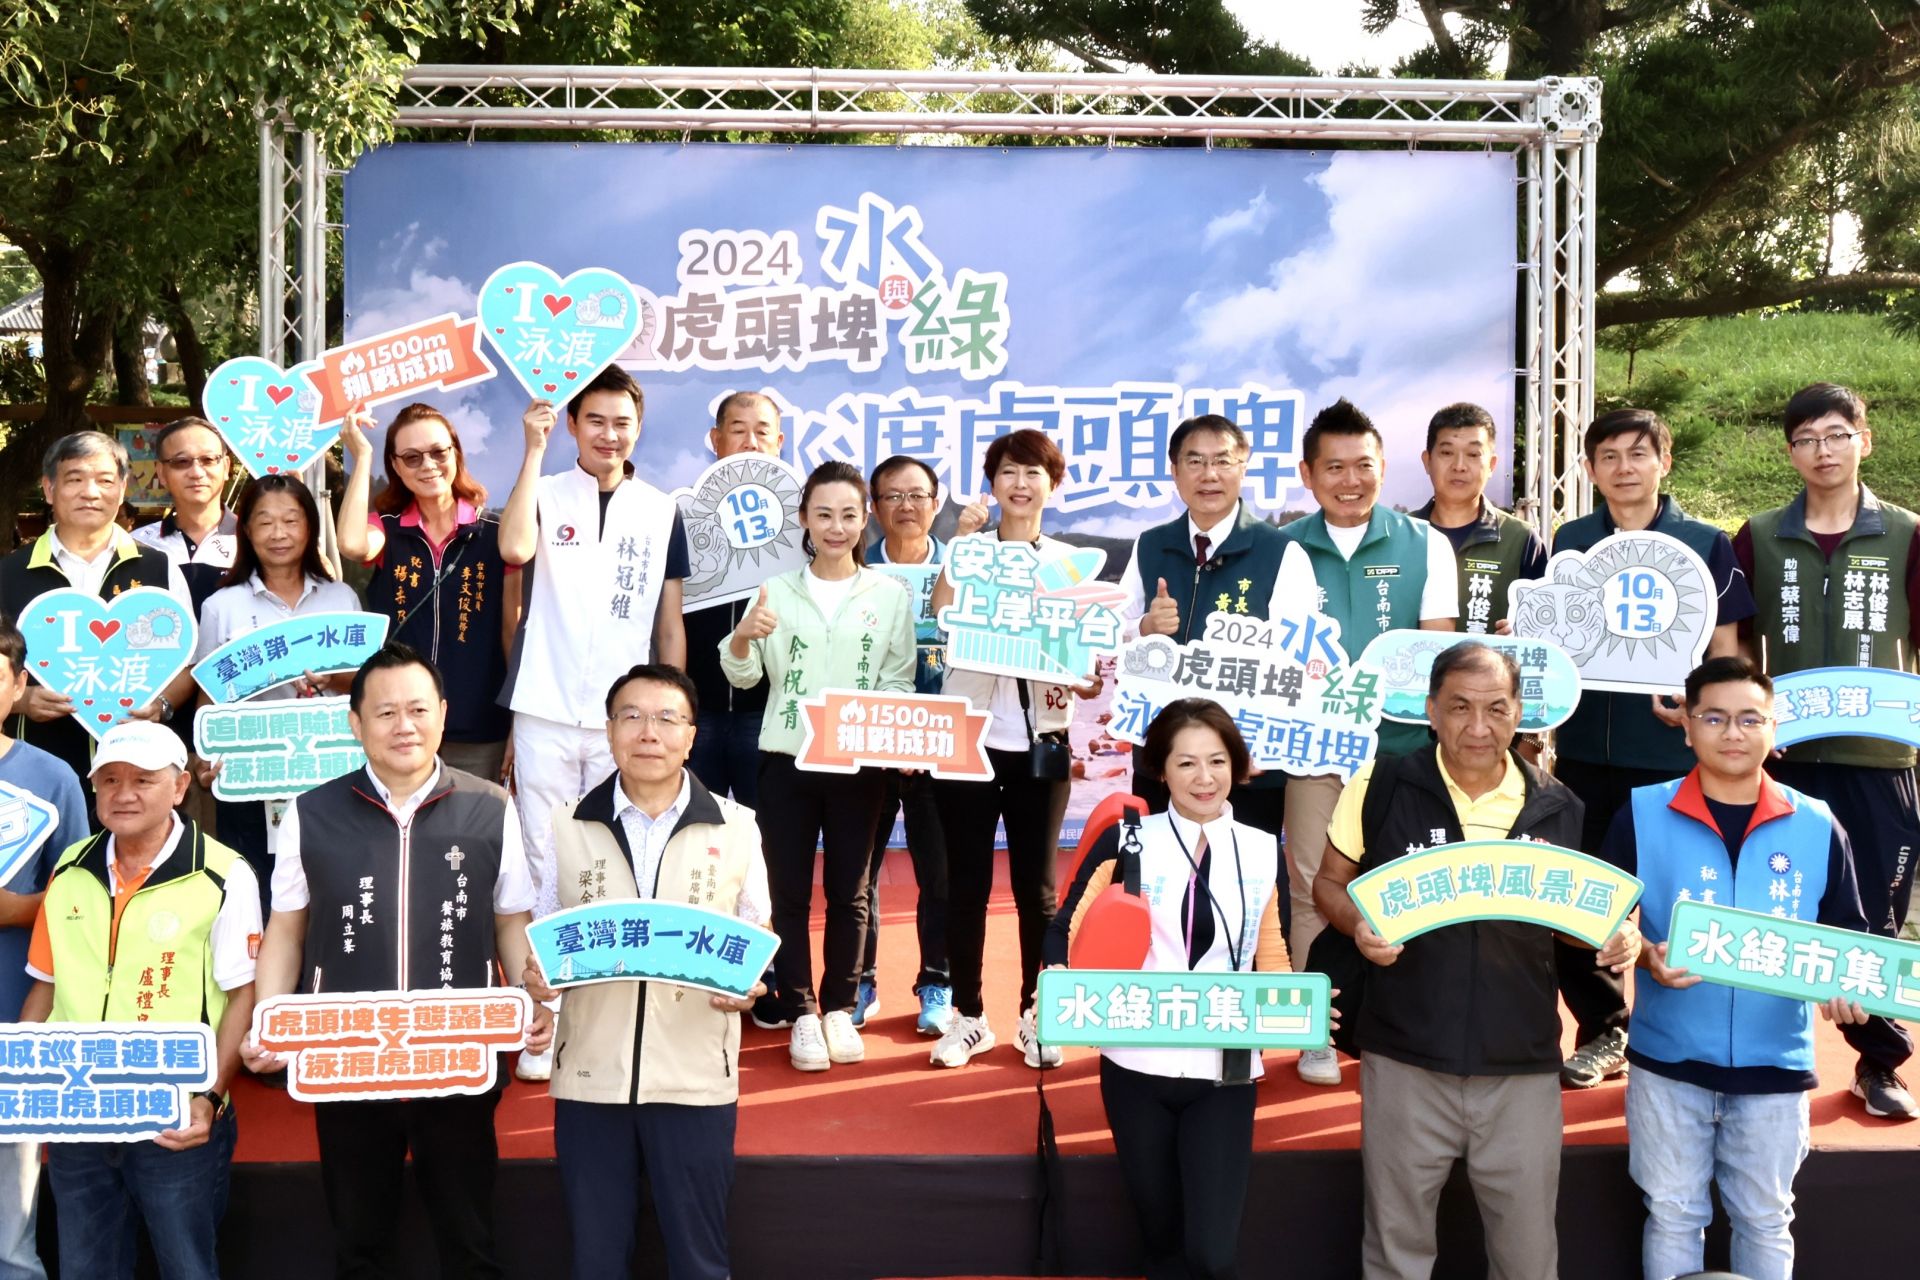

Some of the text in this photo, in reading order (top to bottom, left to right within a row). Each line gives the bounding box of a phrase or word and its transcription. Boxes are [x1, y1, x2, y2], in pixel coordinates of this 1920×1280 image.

[686, 239, 793, 276] 2024
[825, 201, 933, 288] 水
[512, 282, 539, 323] I
[657, 292, 878, 362] 虎頭埤
[909, 279, 1000, 370] 綠
[367, 333, 448, 367] 1500m
[515, 327, 597, 368] 泳渡
[237, 375, 262, 411] I
[341, 349, 455, 402] 挑戰成功
[239, 415, 317, 451] 泳渡
[712, 390, 1297, 504] 渡虎頭埤
[610, 536, 640, 619] 林冠維
[951, 539, 1039, 590] 安全
[945, 584, 1120, 649] 上岸平台
[1234, 578, 1252, 613] 市長
[1375, 579, 1392, 635] 台南市
[1842, 571, 1866, 631] 林志展
[1868, 572, 1890, 632] 林俊憲
[56, 610, 83, 653] I
[212, 623, 367, 683] 臺灣第一水庫
[1210, 618, 1274, 649] 2024
[1279, 614, 1341, 667] 水
[61, 651, 152, 695] 泳渡
[855, 633, 873, 690] 台南市
[1172, 648, 1304, 707] 虎頭埤
[869, 704, 953, 729] 1500m
[1320, 666, 1379, 725] 綠
[1774, 685, 1920, 725] 臺灣第一
[836, 724, 955, 758] 挑戰成功
[1113, 690, 1371, 777] 泳虎頭埤
[359, 876, 374, 925] 理事長
[455, 873, 468, 921] 台南市
[594, 858, 607, 898] 理事長
[1379, 863, 1618, 918] 虎頭埤風景區
[552, 918, 751, 966] 臺灣第一水庫
[1686, 919, 1888, 999] 水綠市集
[157, 951, 176, 998] 理事長
[268, 1003, 518, 1036] 虎頭埤生態露營
[1056, 983, 1249, 1033] 水綠市集
[304, 1048, 481, 1078] 泳渡虎頭埤
